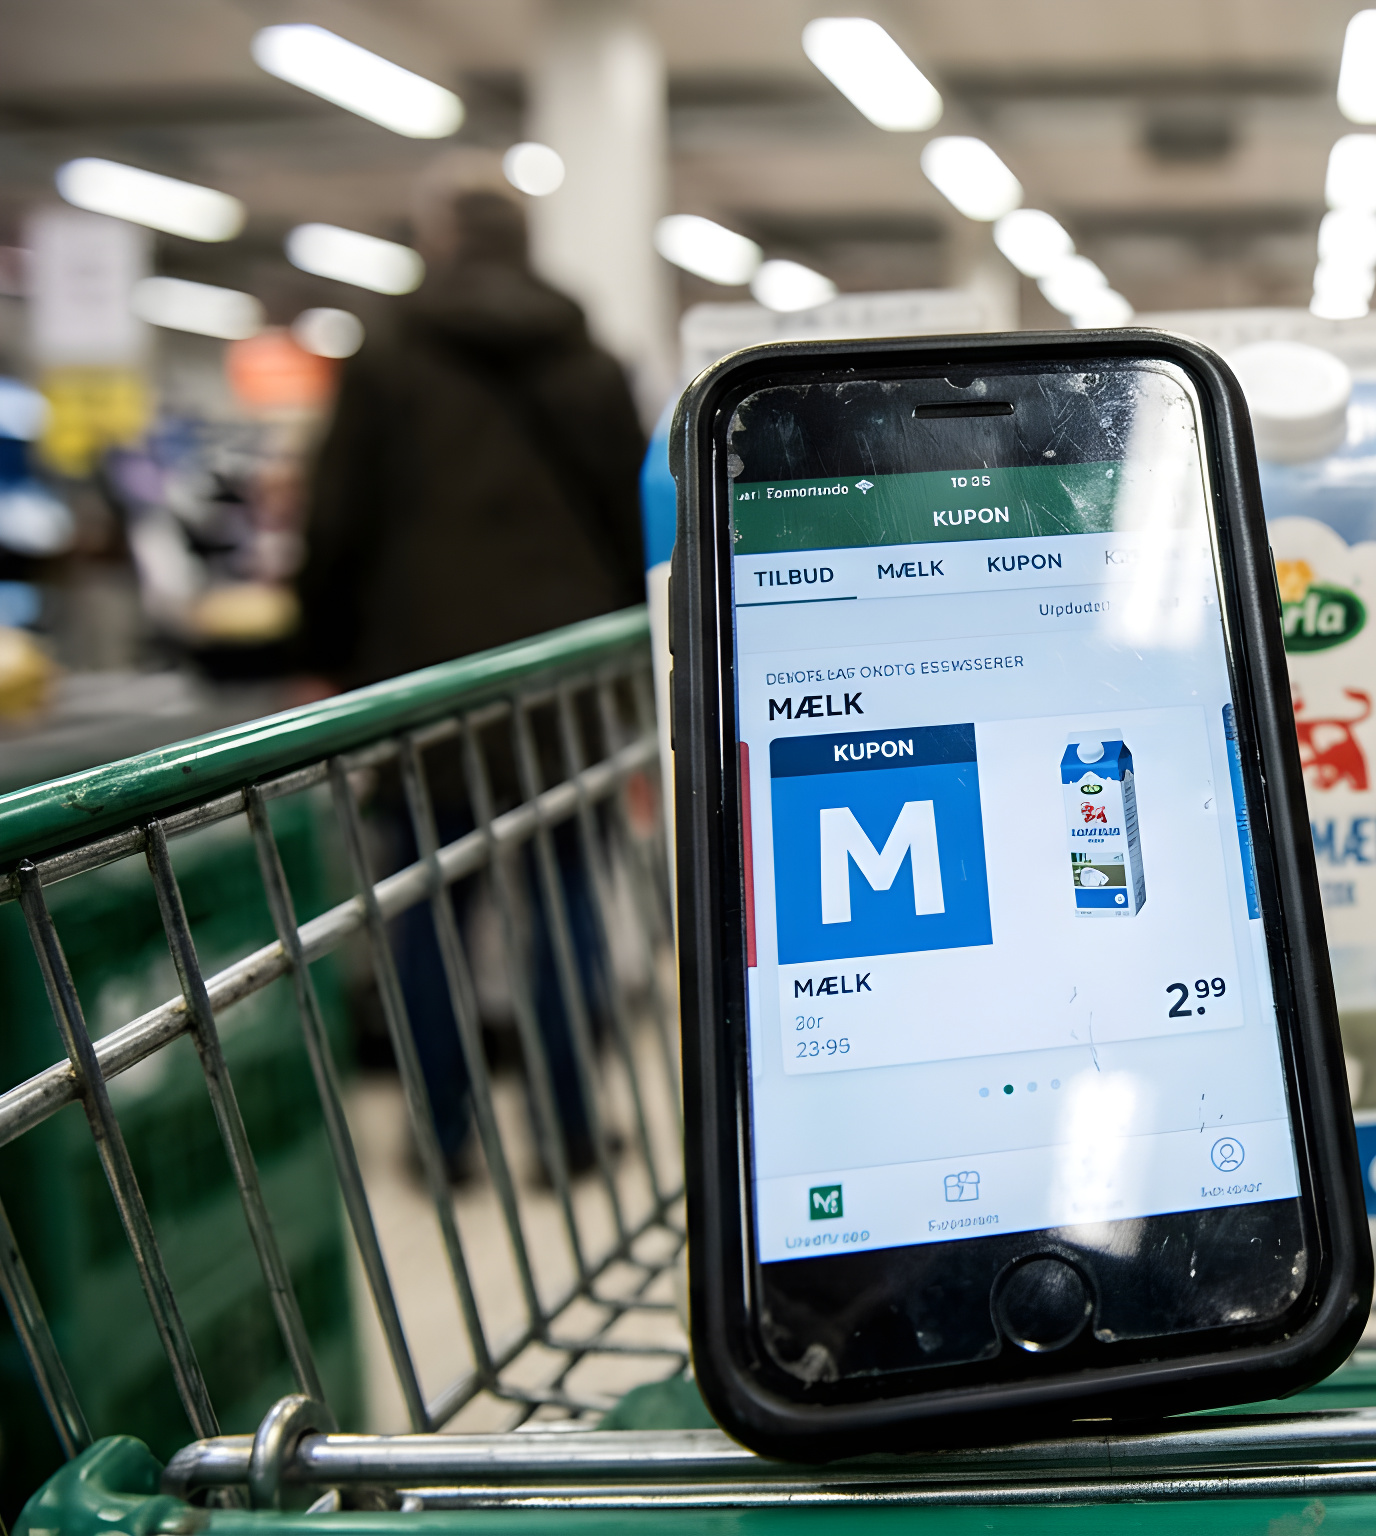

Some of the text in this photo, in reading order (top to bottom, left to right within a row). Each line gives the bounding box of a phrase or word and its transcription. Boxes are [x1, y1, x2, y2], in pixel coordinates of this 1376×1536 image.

[933, 506, 1010, 527] KUPON
[877, 560, 944, 579] MÆLK
[987, 553, 1063, 573] KUPON
[754, 567, 834, 587] TILBUD
[1281, 593, 1346, 637] rla
[768, 692, 865, 721] MÆLK
[833, 739, 914, 761] KUPON
[819, 800, 946, 925] M
[794, 972, 872, 998] MÆLK
